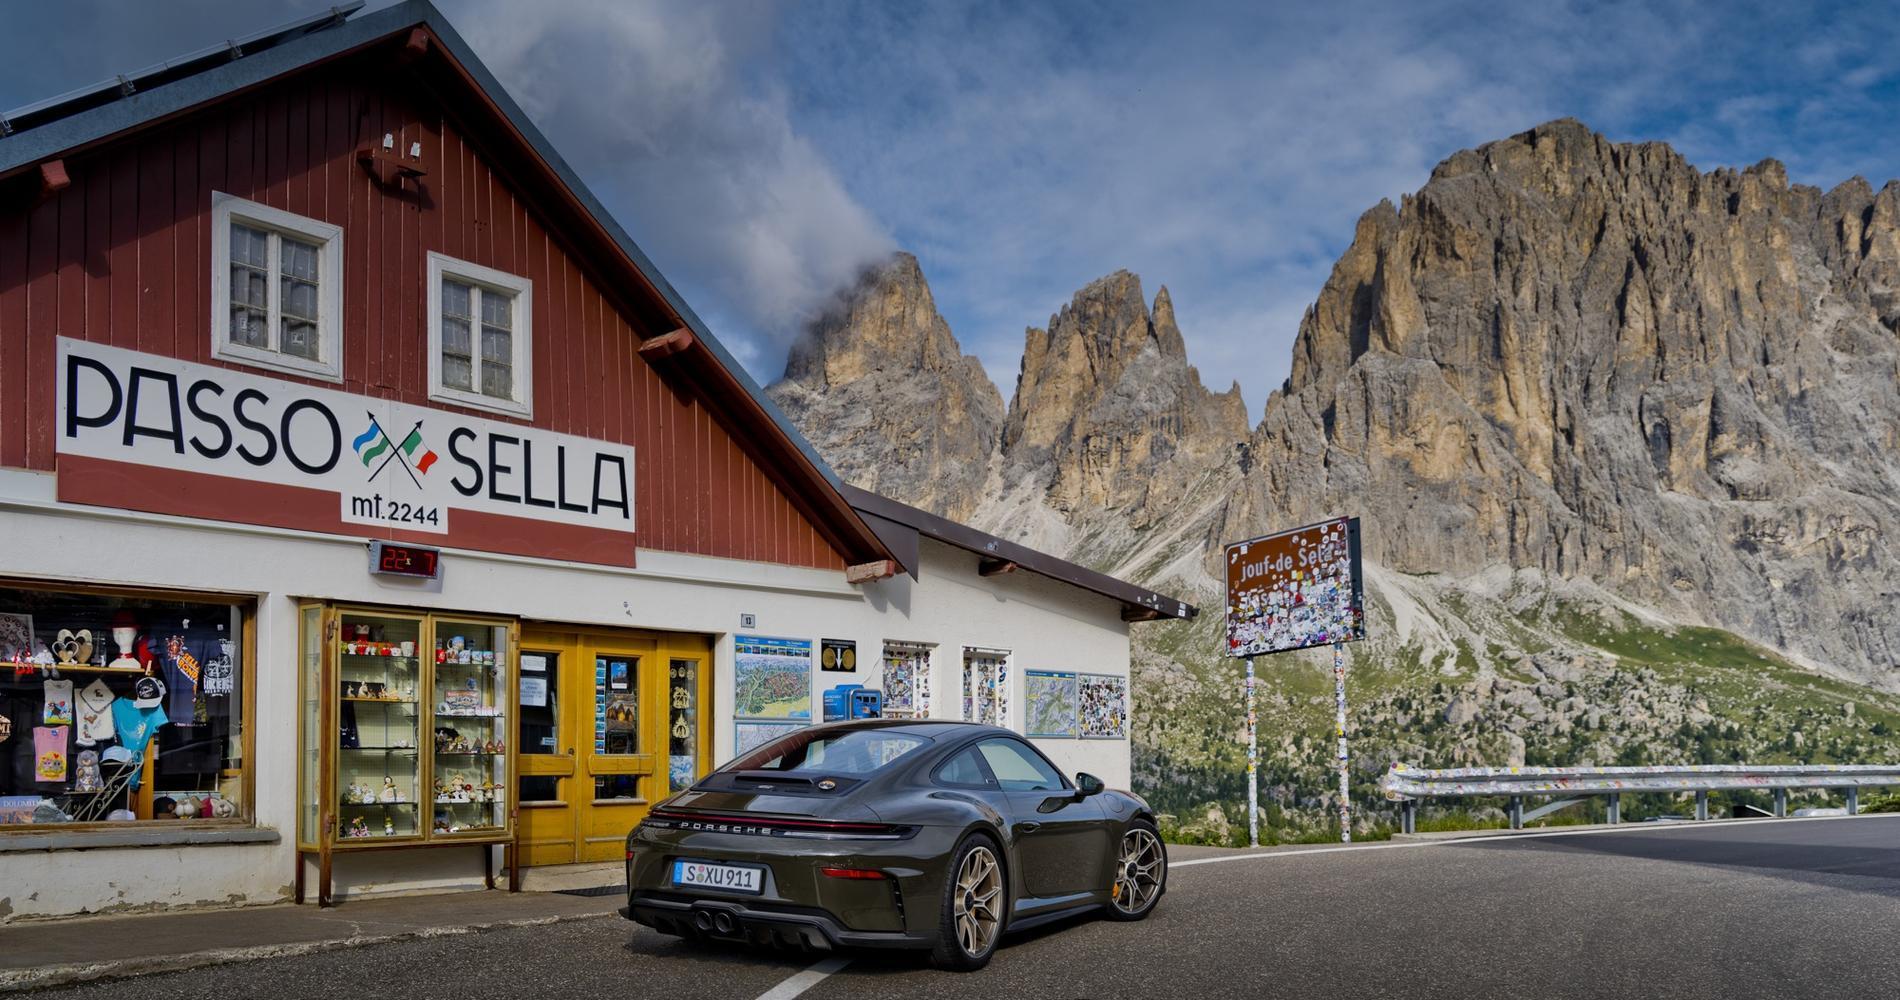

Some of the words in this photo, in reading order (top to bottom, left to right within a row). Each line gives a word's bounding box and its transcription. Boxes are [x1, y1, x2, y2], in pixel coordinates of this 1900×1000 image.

[66, 354, 342, 476] PASSO
[447, 427, 630, 519] SELLA
[1240, 555, 1270, 582] jouf
[1276, 553, 1293, 573] de
[178, 659, 199, 681] ROND
[681, 821, 772, 835] PORSCHE
[686, 865, 696, 881] S
[726, 869, 752, 888] 911
